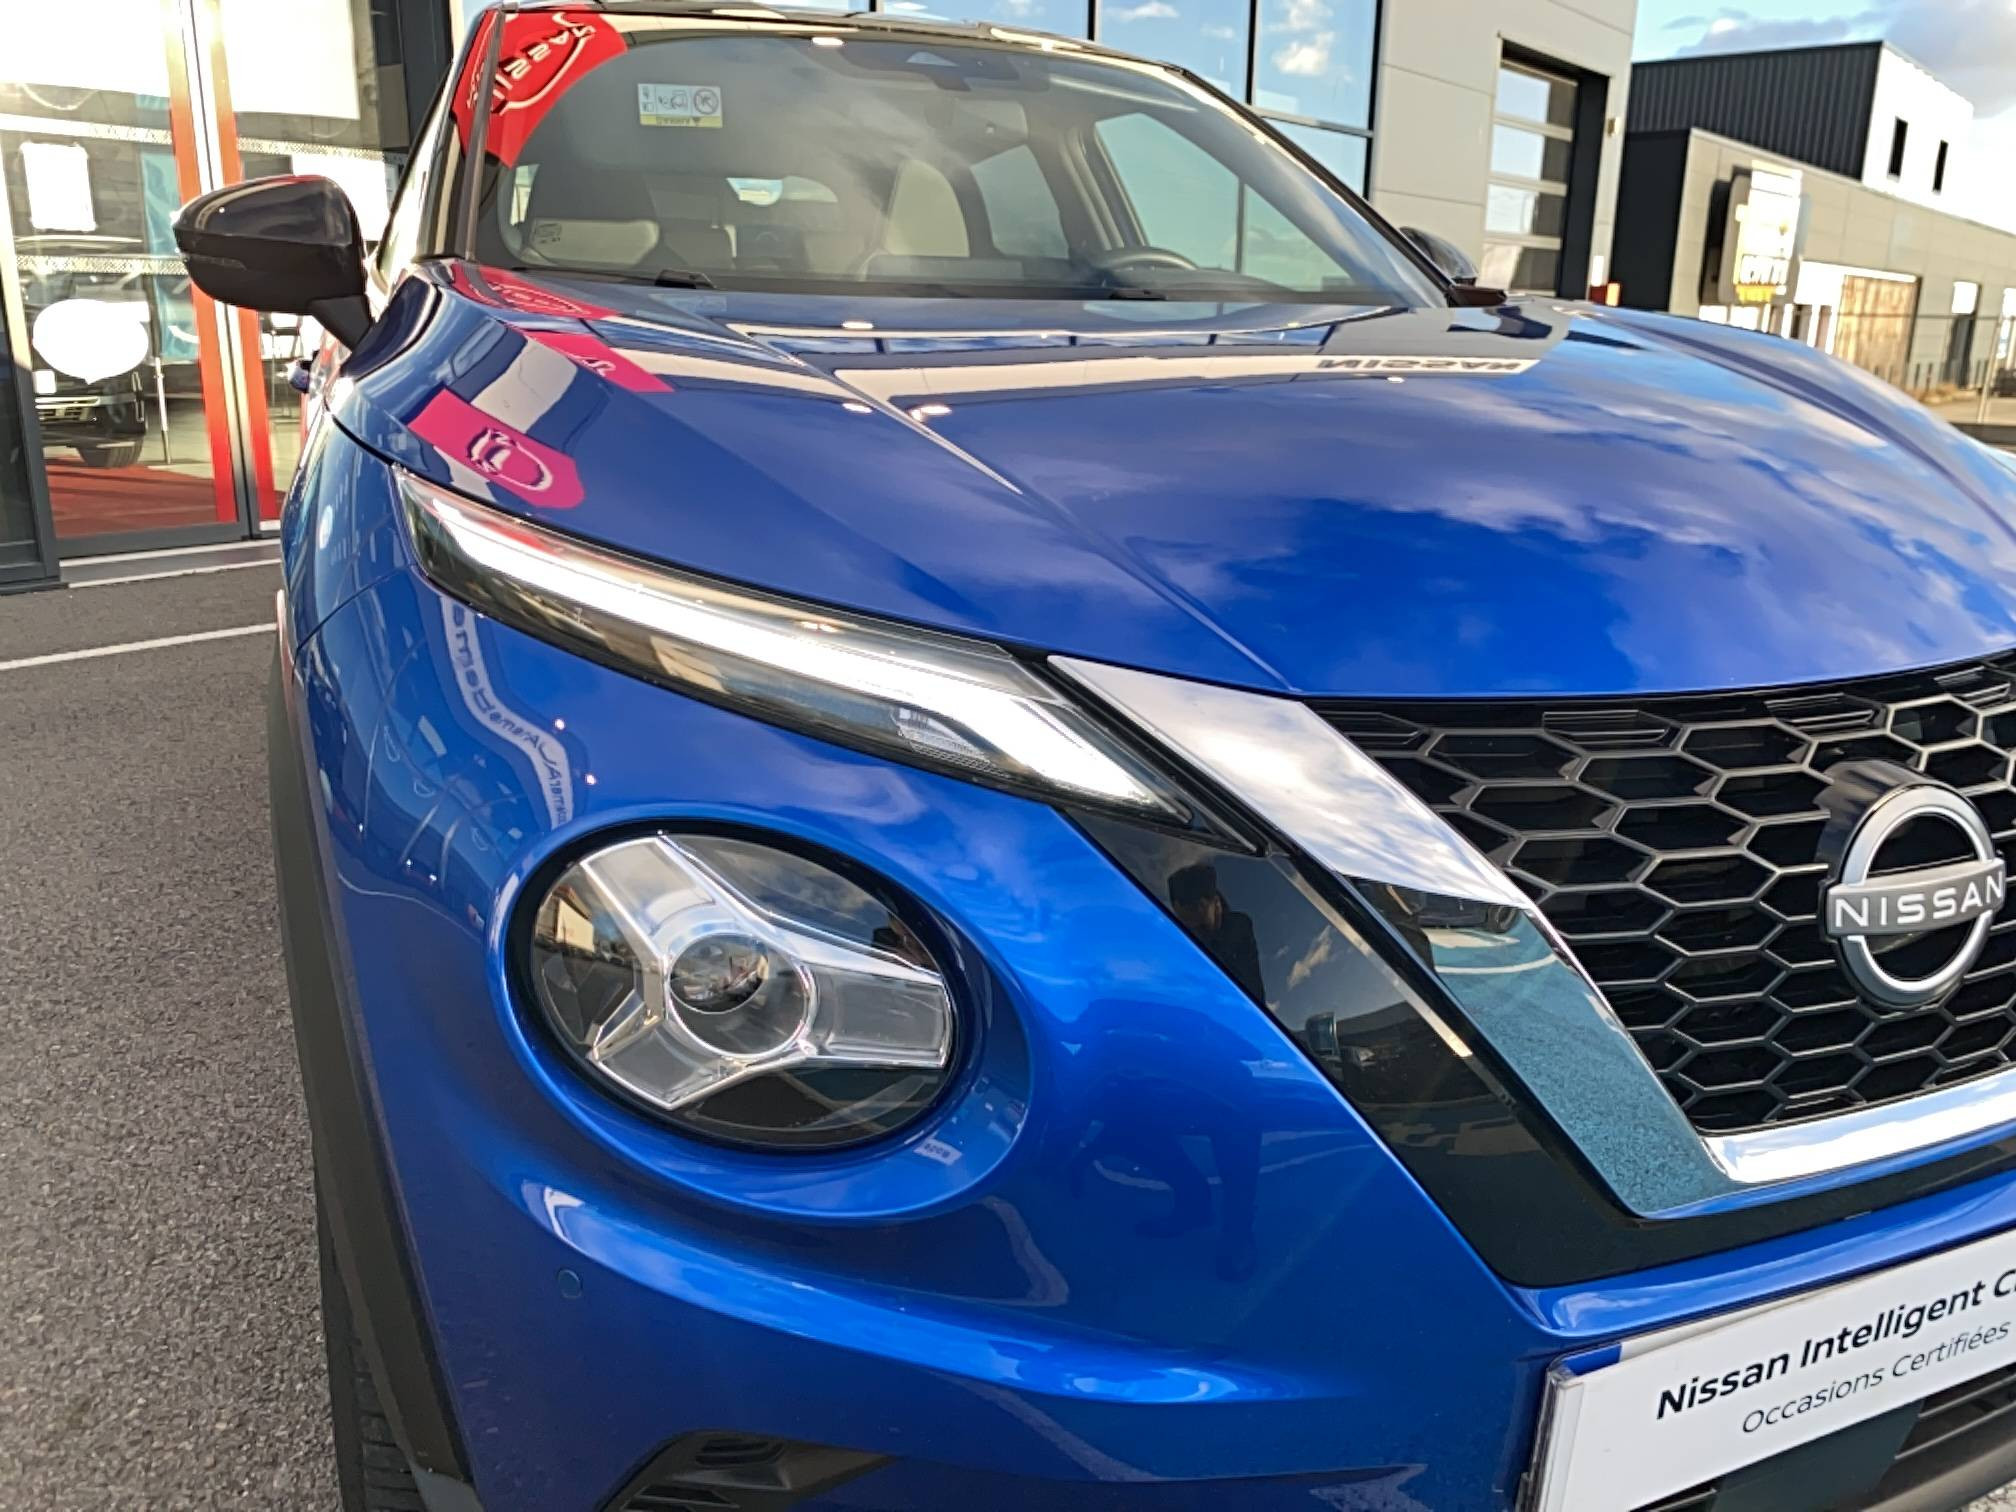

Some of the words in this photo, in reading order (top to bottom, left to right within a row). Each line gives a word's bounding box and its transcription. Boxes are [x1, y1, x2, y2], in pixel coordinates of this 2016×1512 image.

[1835, 870, 2004, 928] NISSAN
[1656, 1350, 1789, 1420] Nissan
[1799, 1280, 1986, 1369] Intelligent
[1993, 1268, 2016, 1298] C
[1742, 1366, 1883, 1434] Occasions
[1892, 1321, 2011, 1377] Certifiées
